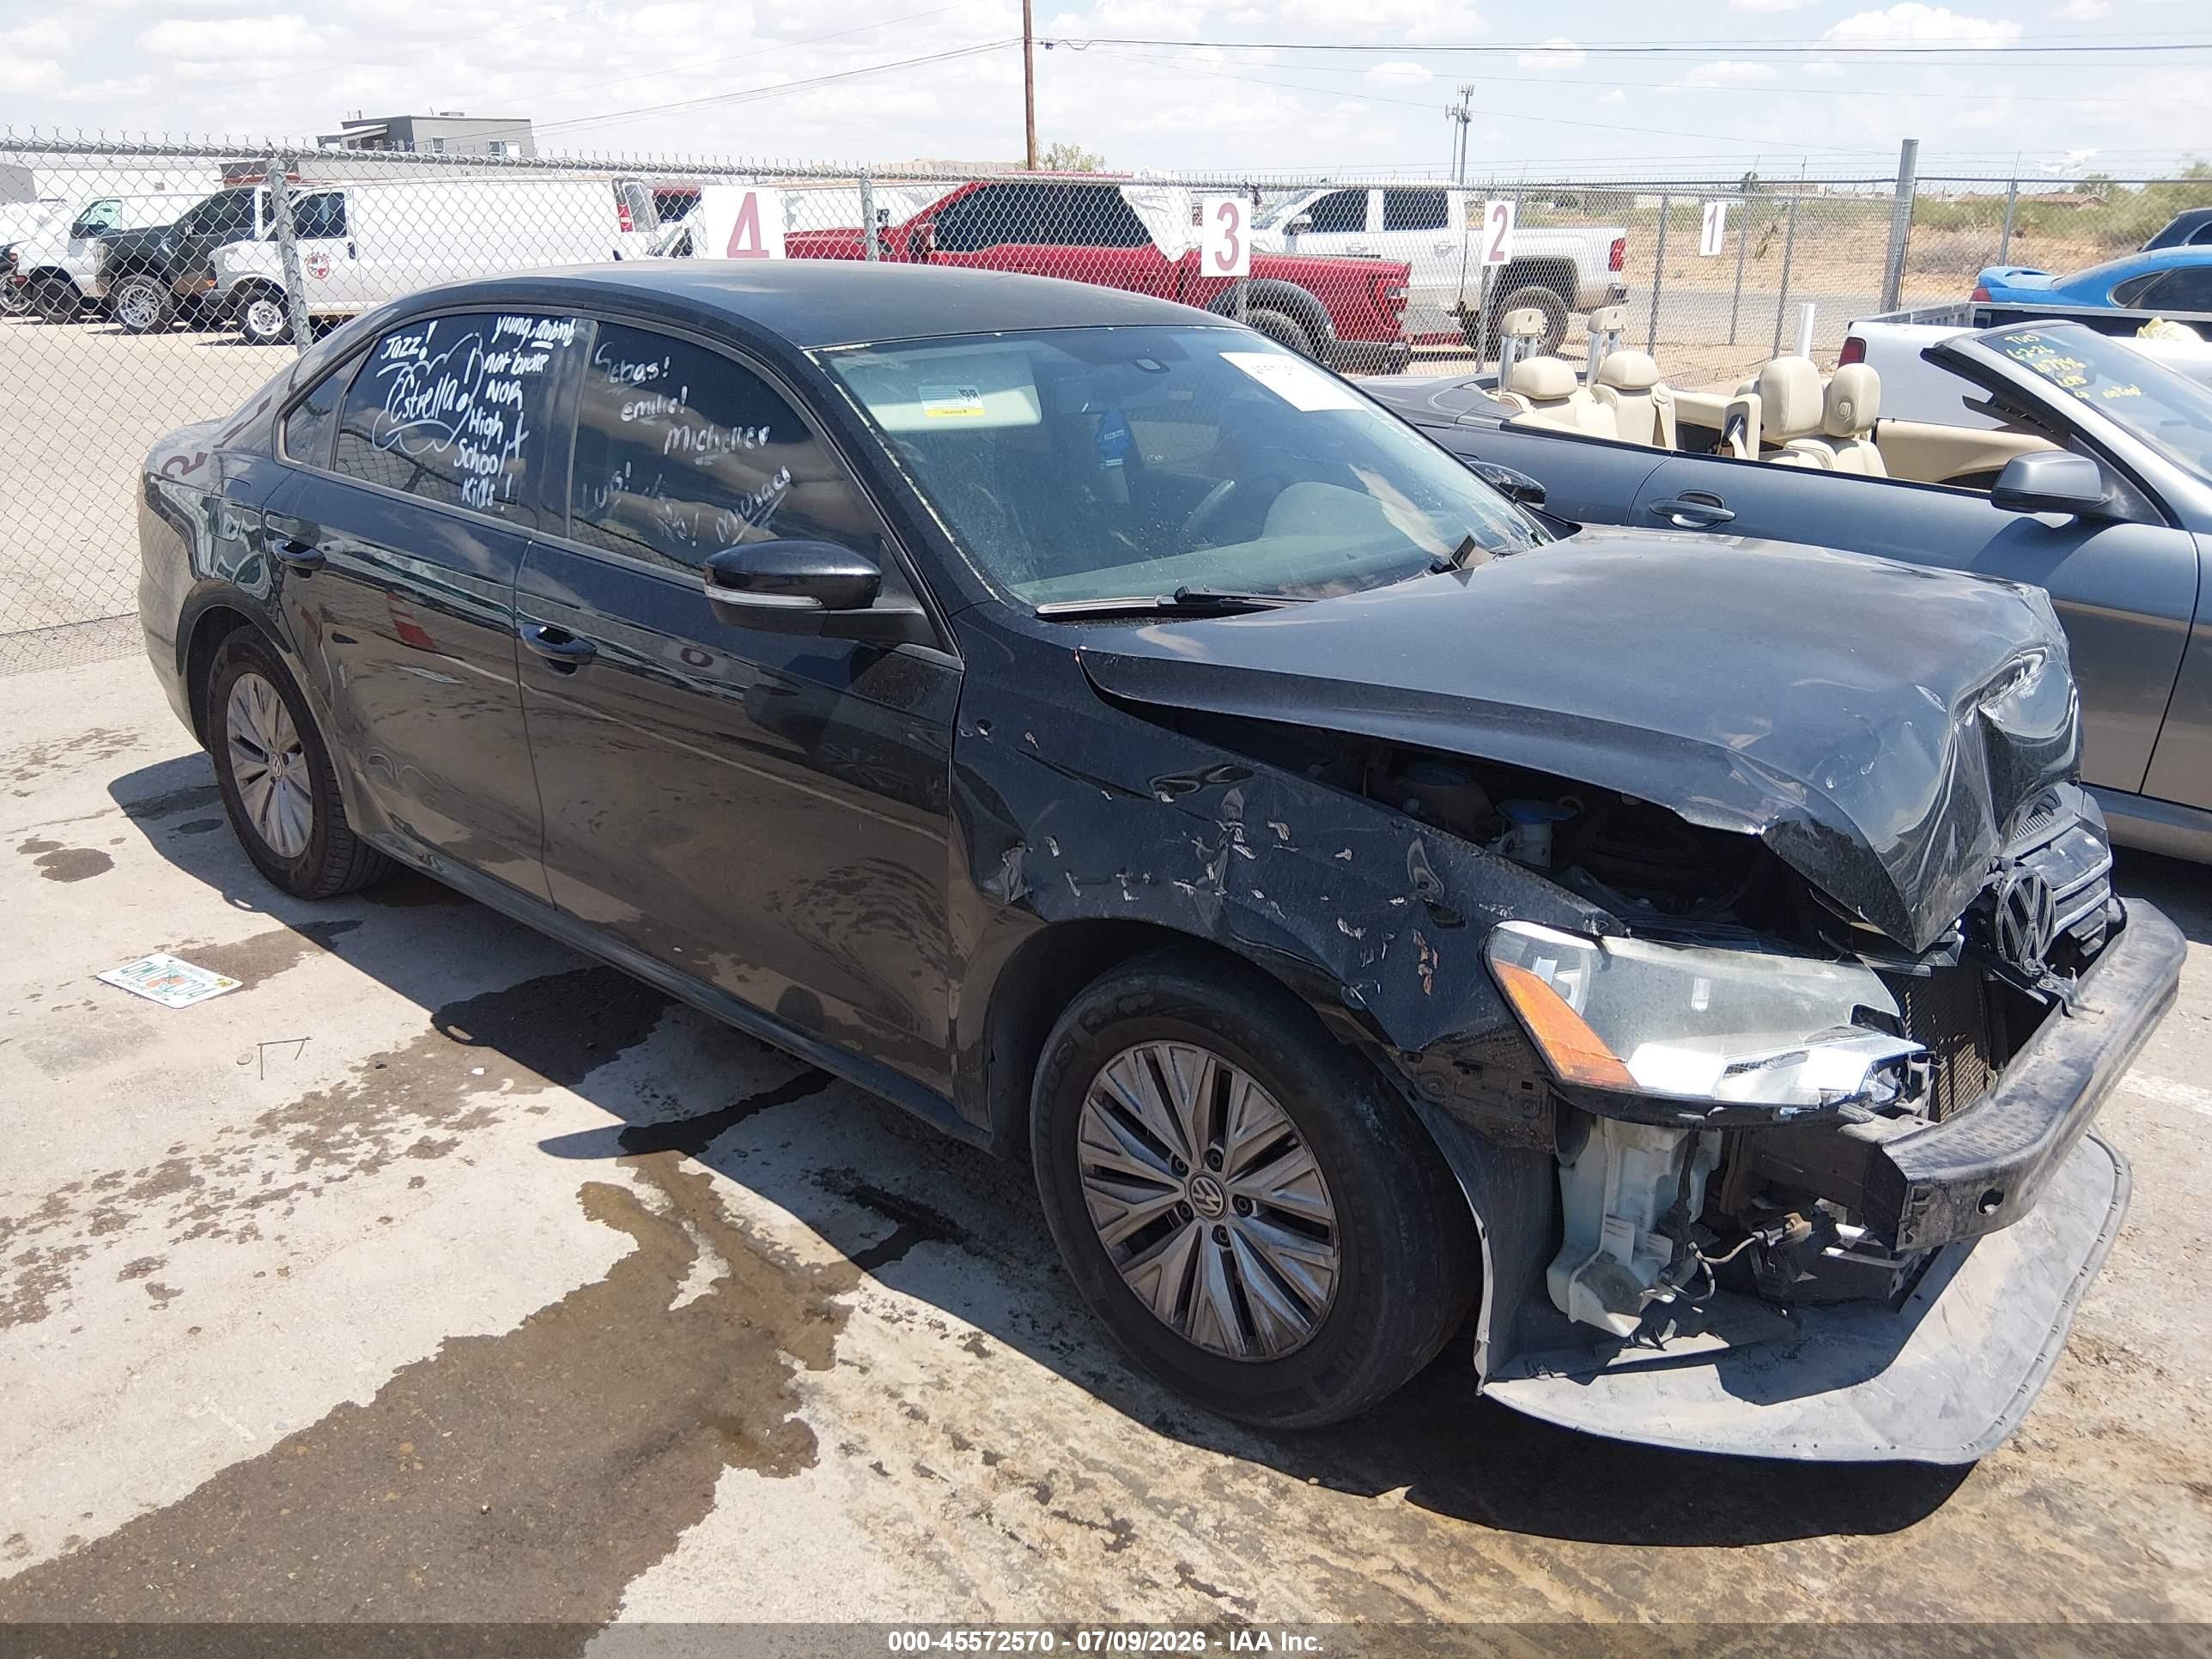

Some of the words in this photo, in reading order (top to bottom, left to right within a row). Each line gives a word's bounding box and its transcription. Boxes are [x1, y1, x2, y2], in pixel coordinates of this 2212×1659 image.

[727, 192, 769, 258] 4
[1214, 202, 1239, 271] 3
[1488, 204, 1508, 262] 2
[1708, 205, 1718, 252] 1
[483, 351, 512, 374] not
[468, 405, 503, 451] High
[453, 437, 510, 478] School
